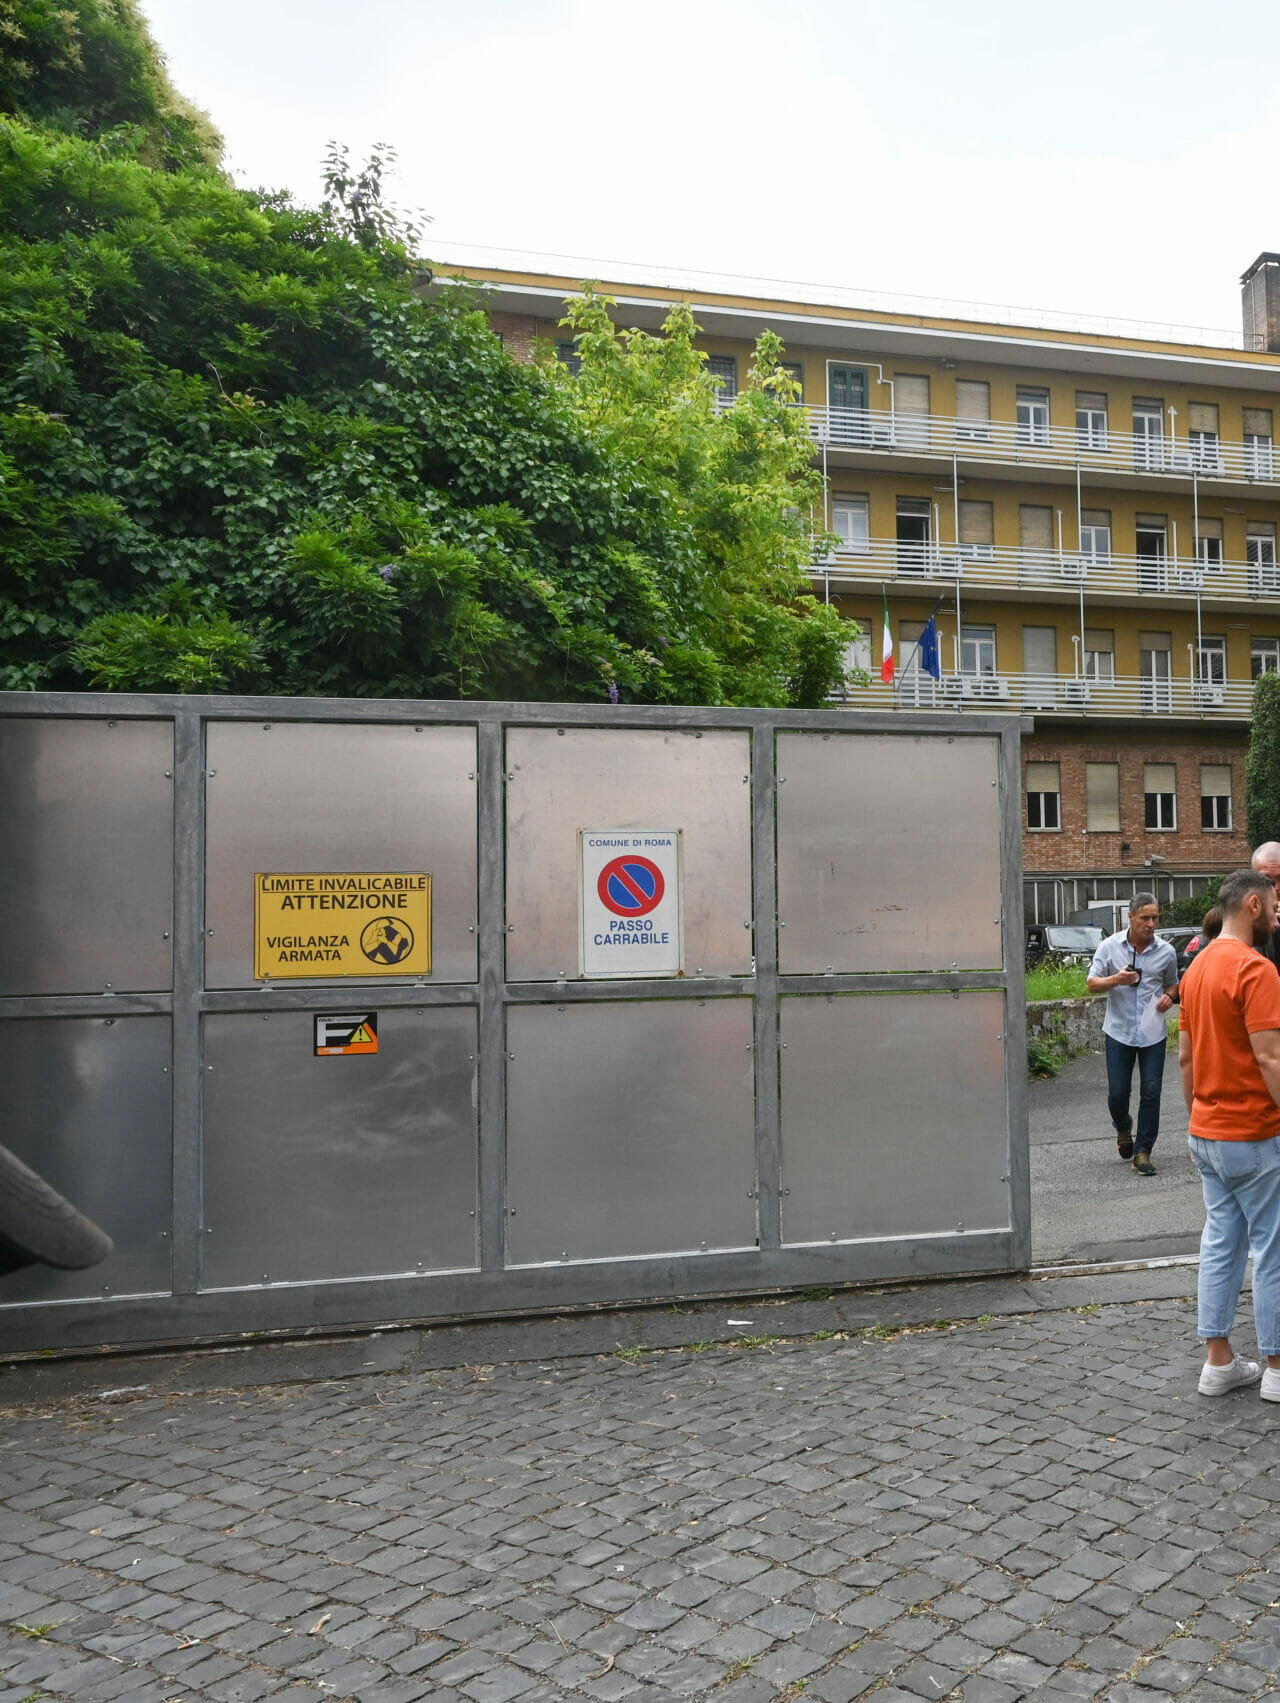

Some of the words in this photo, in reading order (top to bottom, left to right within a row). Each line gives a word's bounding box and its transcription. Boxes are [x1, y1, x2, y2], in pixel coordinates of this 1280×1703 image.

[588, 839, 630, 847] COMUNE
[632, 839, 642, 847] DI
[644, 839, 672, 847] ROMA
[262, 878, 315, 892] LIMITE
[319, 877, 426, 891] INVALICABILE
[281, 893, 408, 910] ATTENZIONE
[609, 919, 653, 932] PASSO
[266, 935, 350, 949] VIGILANZA
[594, 932, 670, 946] CARRABILE
[278, 950, 342, 963] ARMATA
